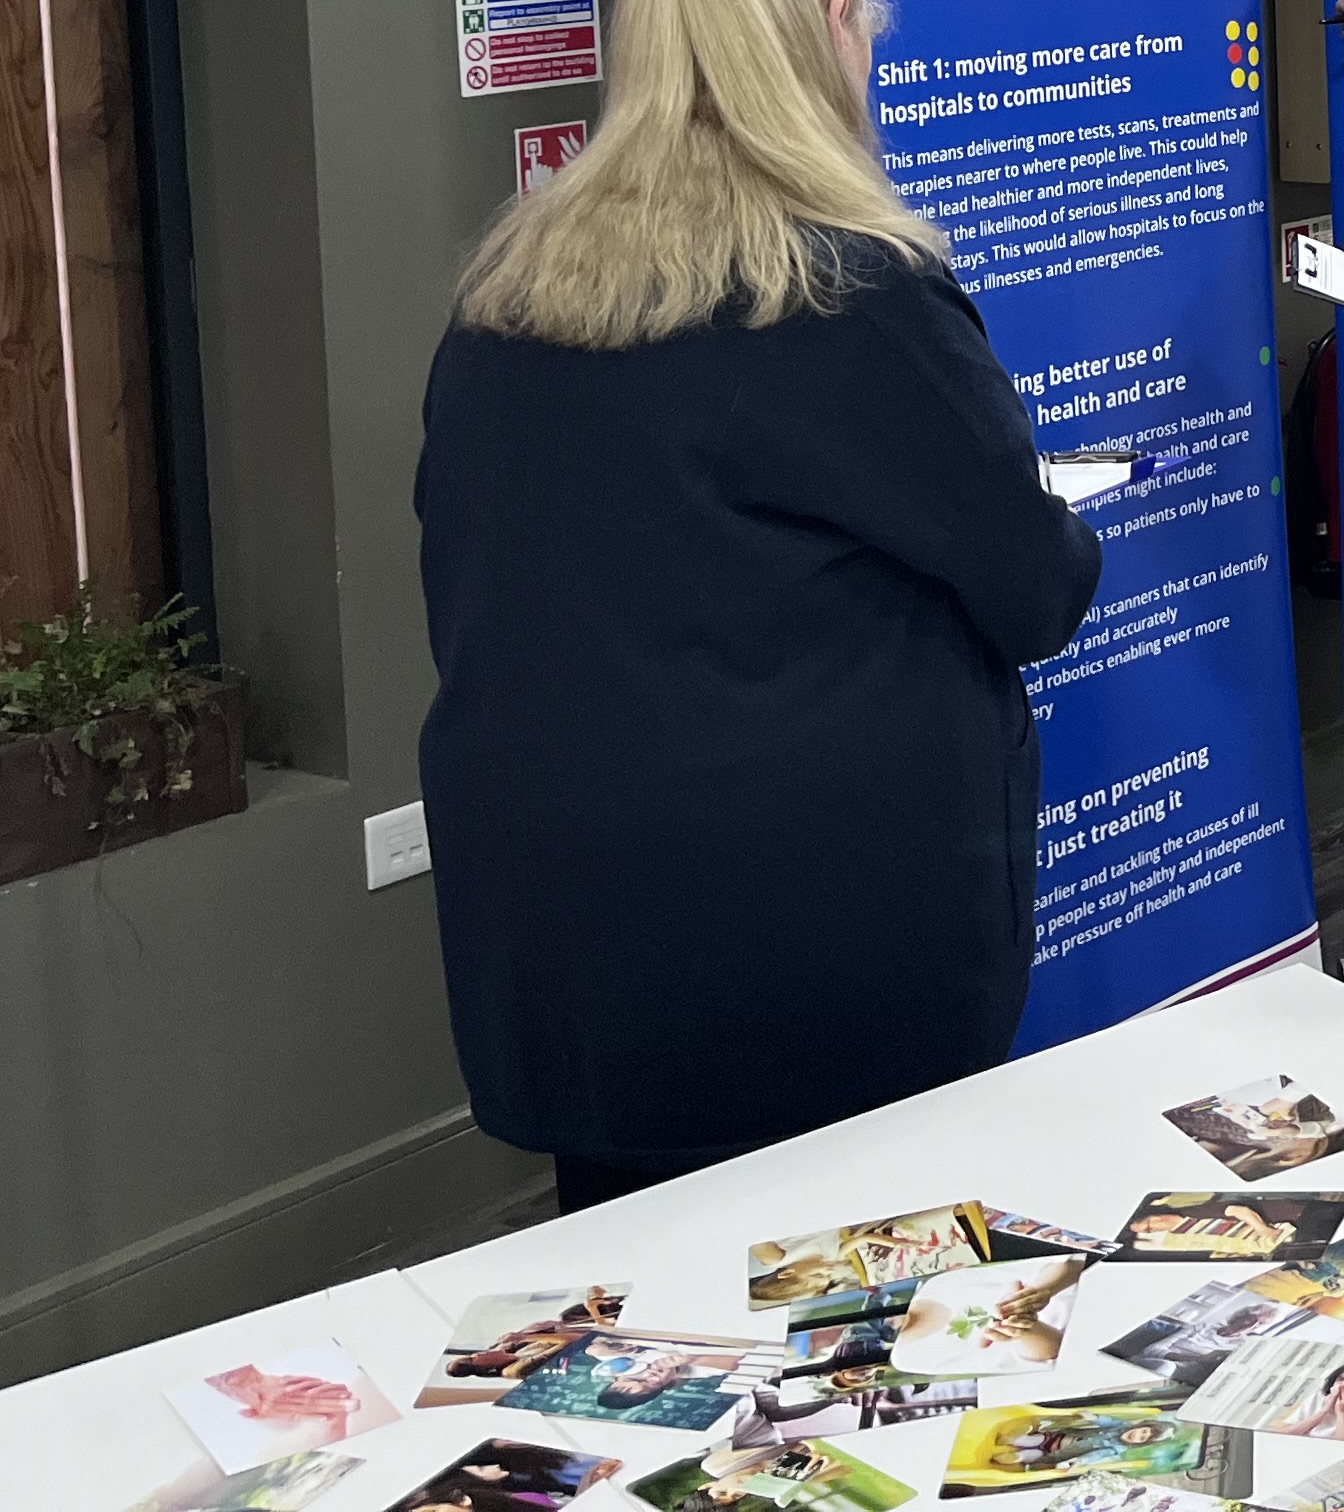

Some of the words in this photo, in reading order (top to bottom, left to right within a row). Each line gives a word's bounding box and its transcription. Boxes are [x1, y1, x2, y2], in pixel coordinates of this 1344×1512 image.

[877, 59, 928, 87] Shift
[932, 57, 951, 80] 1:
[955, 49, 1028, 77] moving
[1031, 46, 1085, 68] more
[1089, 40, 1131, 61] care
[1134, 34, 1183, 56] from
[880, 91, 974, 127] hospitals
[977, 91, 999, 112] to
[1003, 73, 1132, 108] communities
[1048, 357, 1111, 387] better
[1114, 349, 1148, 371] use
[1151, 337, 1172, 362] of
[1037, 391, 1101, 426] health
[1105, 380, 1141, 409] and
[1145, 375, 1187, 398] care
[1103, 587, 1161, 619] scanners
[1162, 577, 1191, 598] that
[1192, 570, 1217, 588] can
[1219, 552, 1269, 580] identify
[1080, 789, 1107, 812] on
[1111, 746, 1210, 807] preventing
[1046, 830, 1087, 869] just
[1090, 798, 1166, 844] treating
[1168, 790, 1183, 811] it
